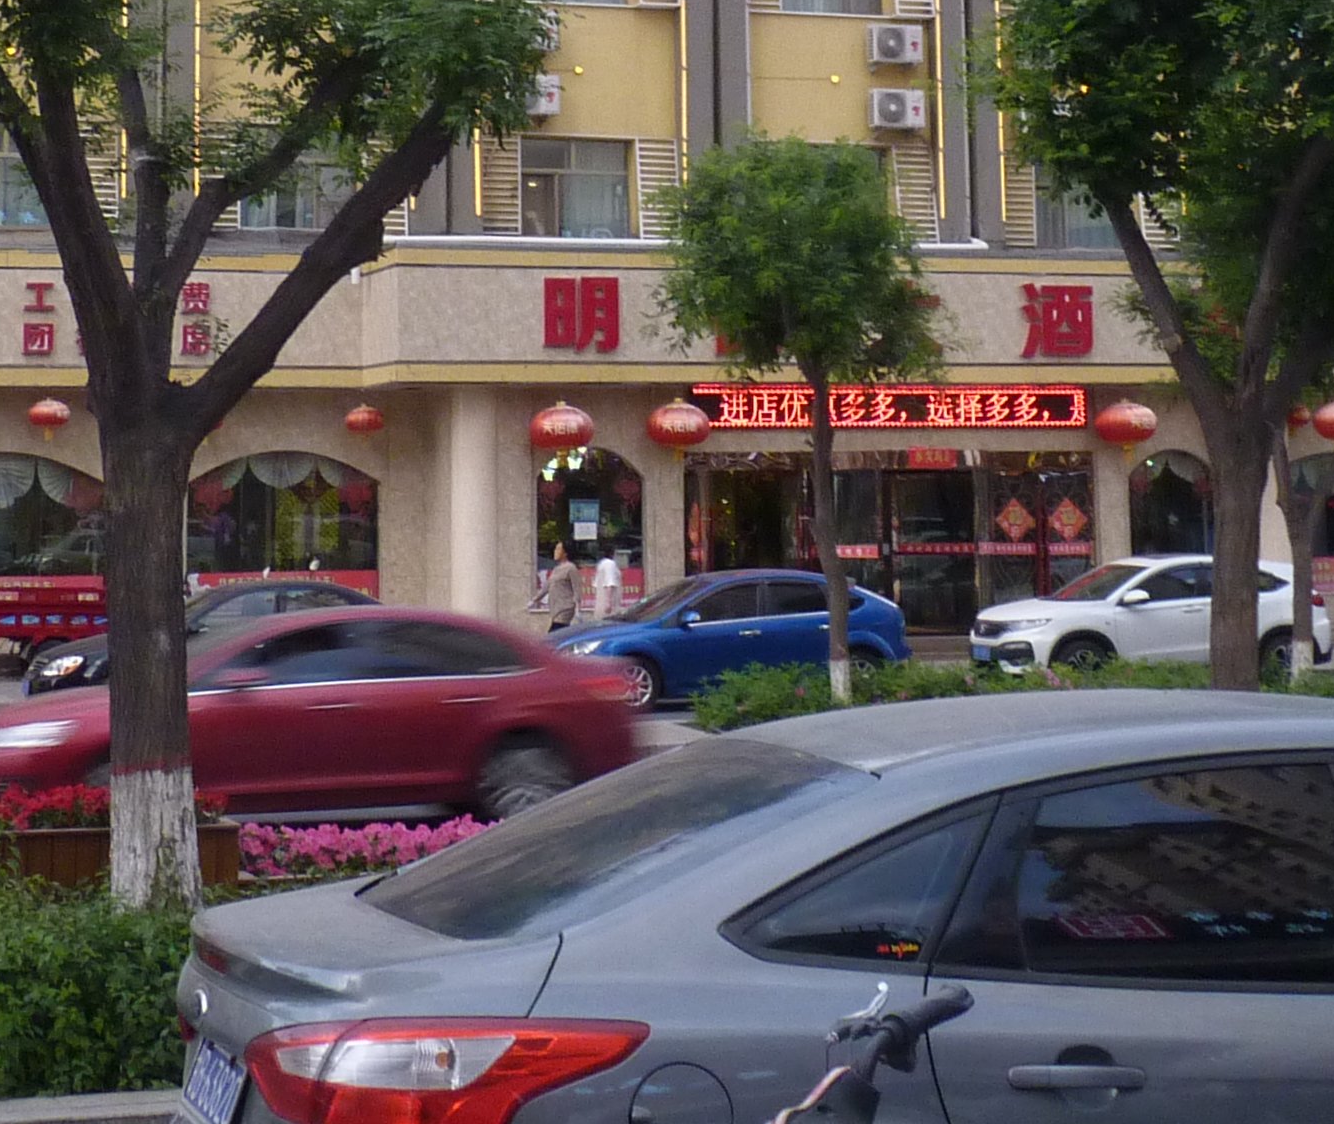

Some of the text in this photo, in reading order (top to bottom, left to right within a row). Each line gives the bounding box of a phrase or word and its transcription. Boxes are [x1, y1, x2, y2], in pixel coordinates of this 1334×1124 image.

[23, 281, 211, 314] 工费
[719, 392, 1086, 424] 进店优多多，选择多多，
